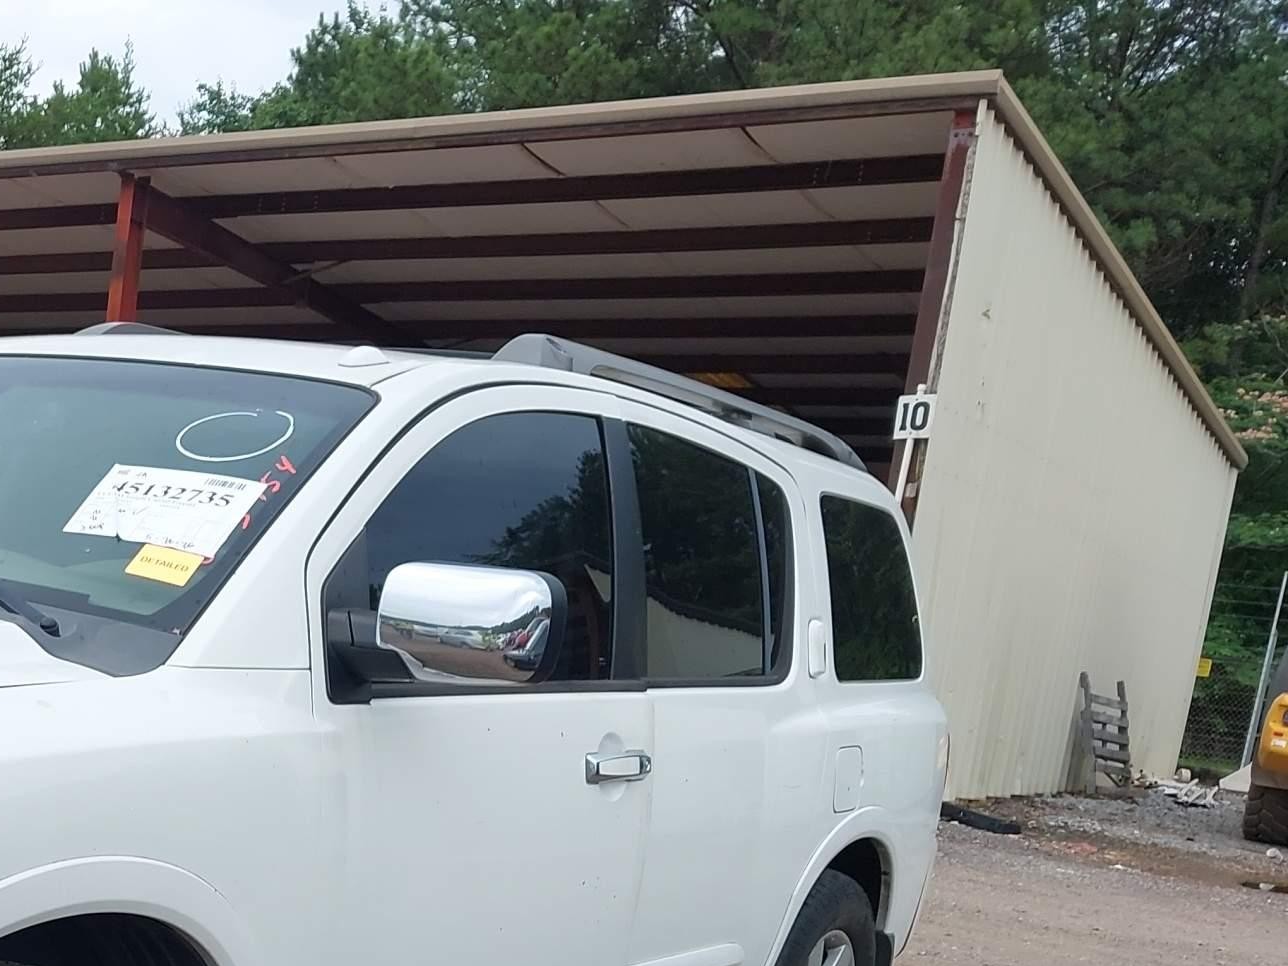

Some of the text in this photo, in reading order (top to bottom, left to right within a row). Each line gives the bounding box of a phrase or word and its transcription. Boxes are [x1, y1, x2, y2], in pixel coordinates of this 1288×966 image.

[899, 401, 931, 431] 10
[112, 481, 235, 508] 45132735
[140, 555, 189, 572] DETAILED
